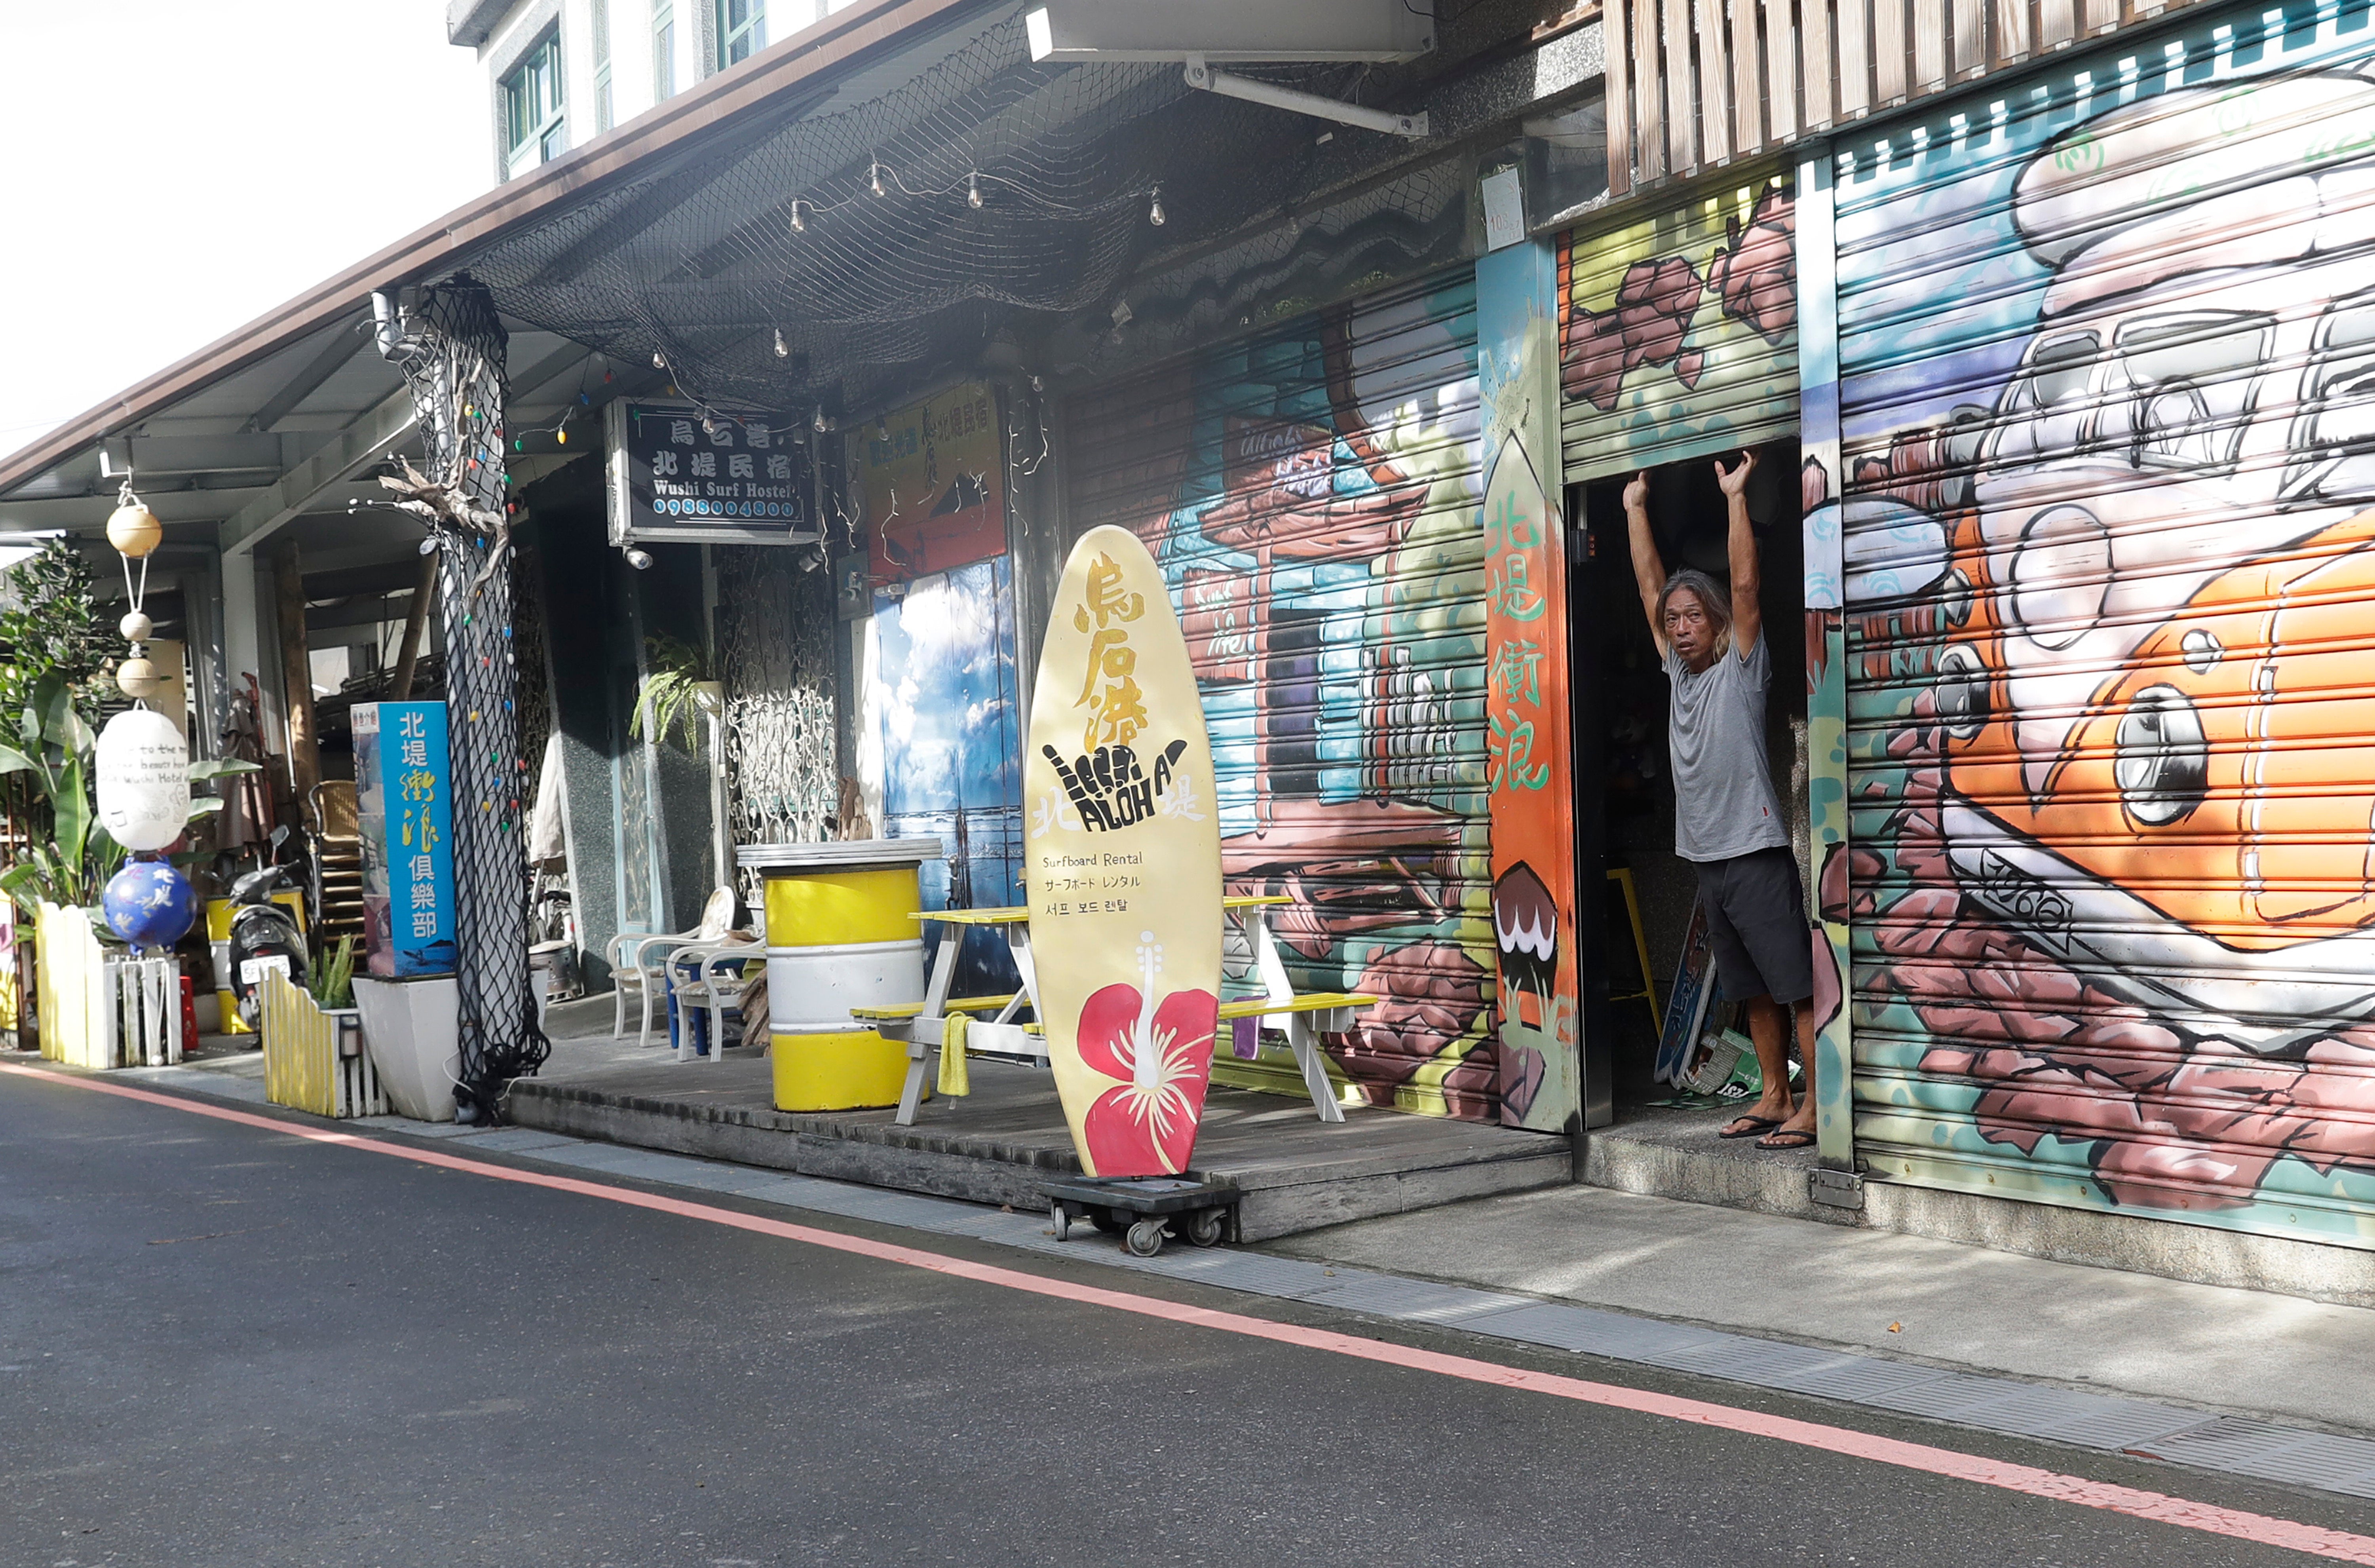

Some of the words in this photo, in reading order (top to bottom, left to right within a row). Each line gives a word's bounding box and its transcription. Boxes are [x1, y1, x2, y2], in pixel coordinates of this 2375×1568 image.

[652, 450, 791, 479] 北堤民宿
[654, 479, 699, 496] Wushi
[707, 482, 739, 497] Surf
[747, 483, 791, 498] Hostel
[653, 498, 794, 517] 0988004800
[1486, 490, 1548, 793] 北堤衝浪
[1075, 754, 1171, 832] ALOHA
[399, 711, 439, 939] 北堤衝浪俱樂部
[1043, 852, 1097, 868] Surfboard
[1104, 851, 1144, 867] Rental
[1045, 877, 1096, 891] サーフボード
[1103, 875, 1140, 889] レンタル
[1045, 904, 1070, 916] 서프
[1077, 901, 1100, 914] 보드
